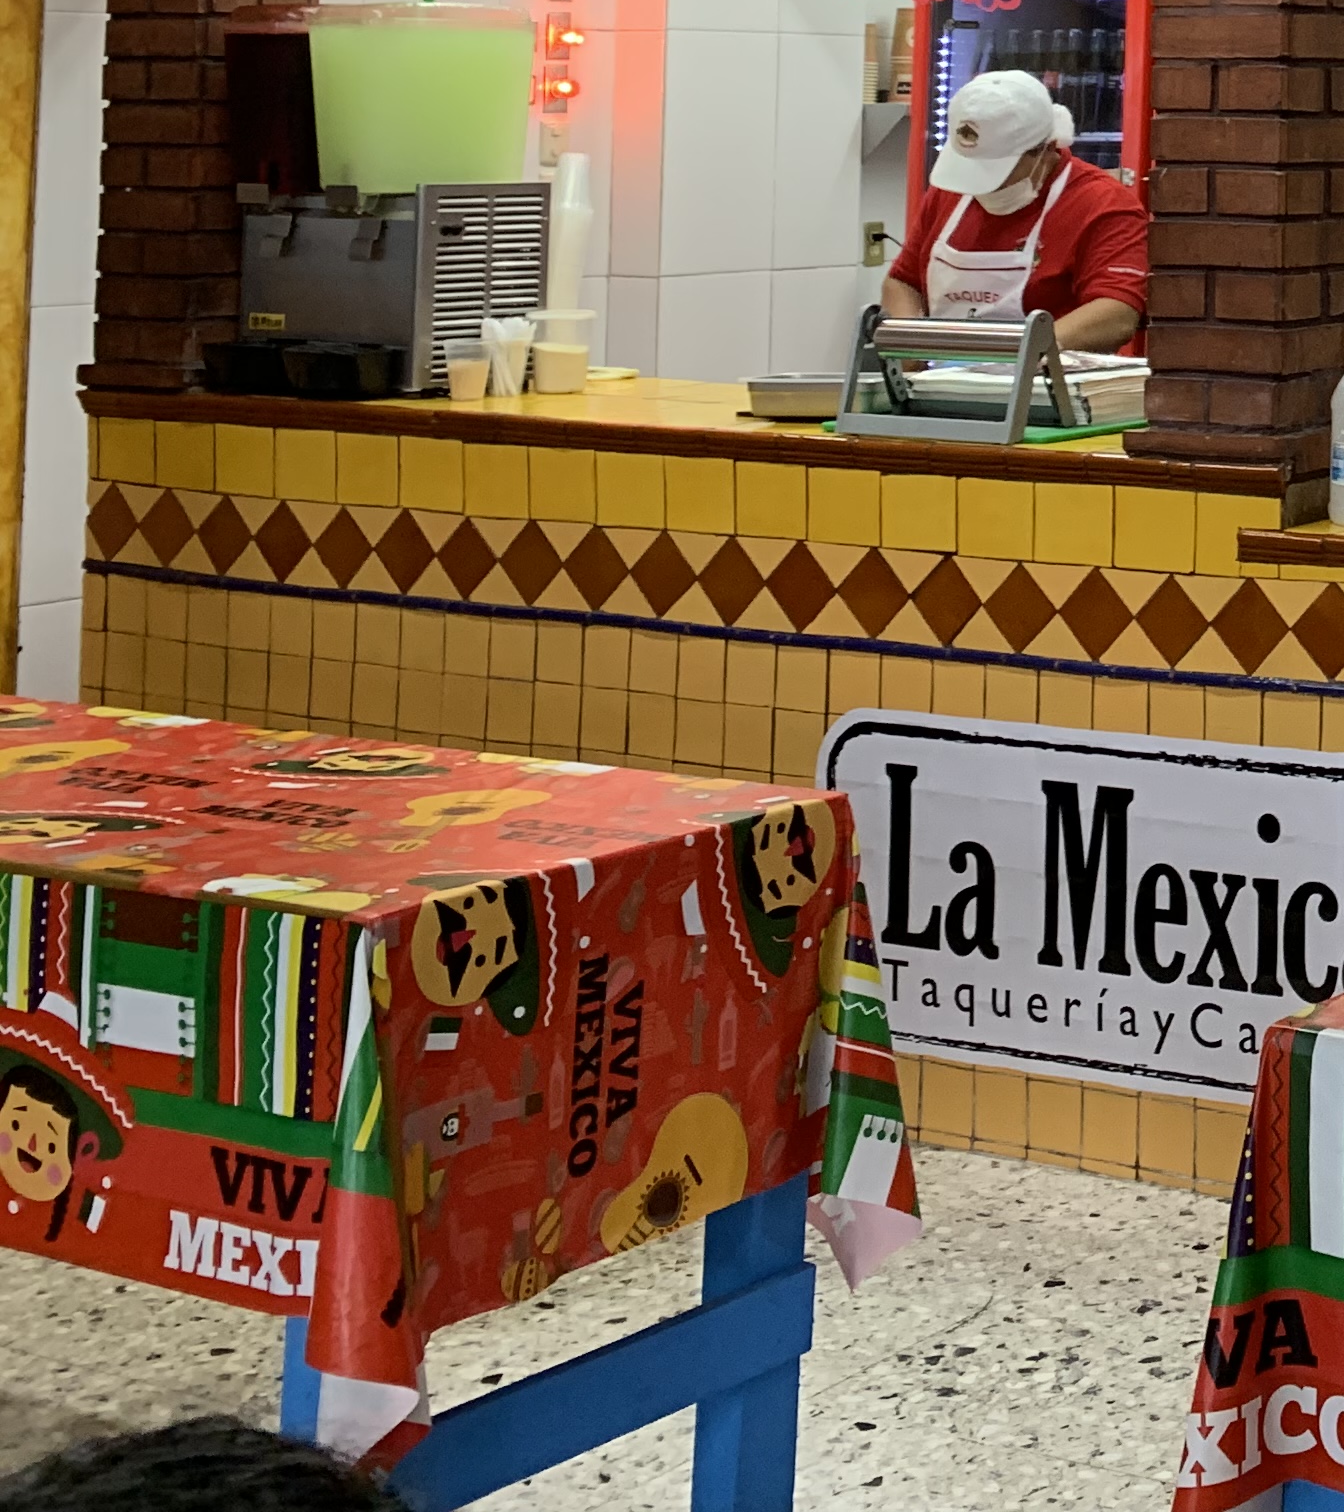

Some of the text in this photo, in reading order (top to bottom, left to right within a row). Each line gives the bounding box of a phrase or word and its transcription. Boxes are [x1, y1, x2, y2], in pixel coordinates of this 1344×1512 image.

[880, 762, 999, 961] La
[566, 953, 612, 1178] MEXICO
[605, 980, 647, 1129] VIVA
